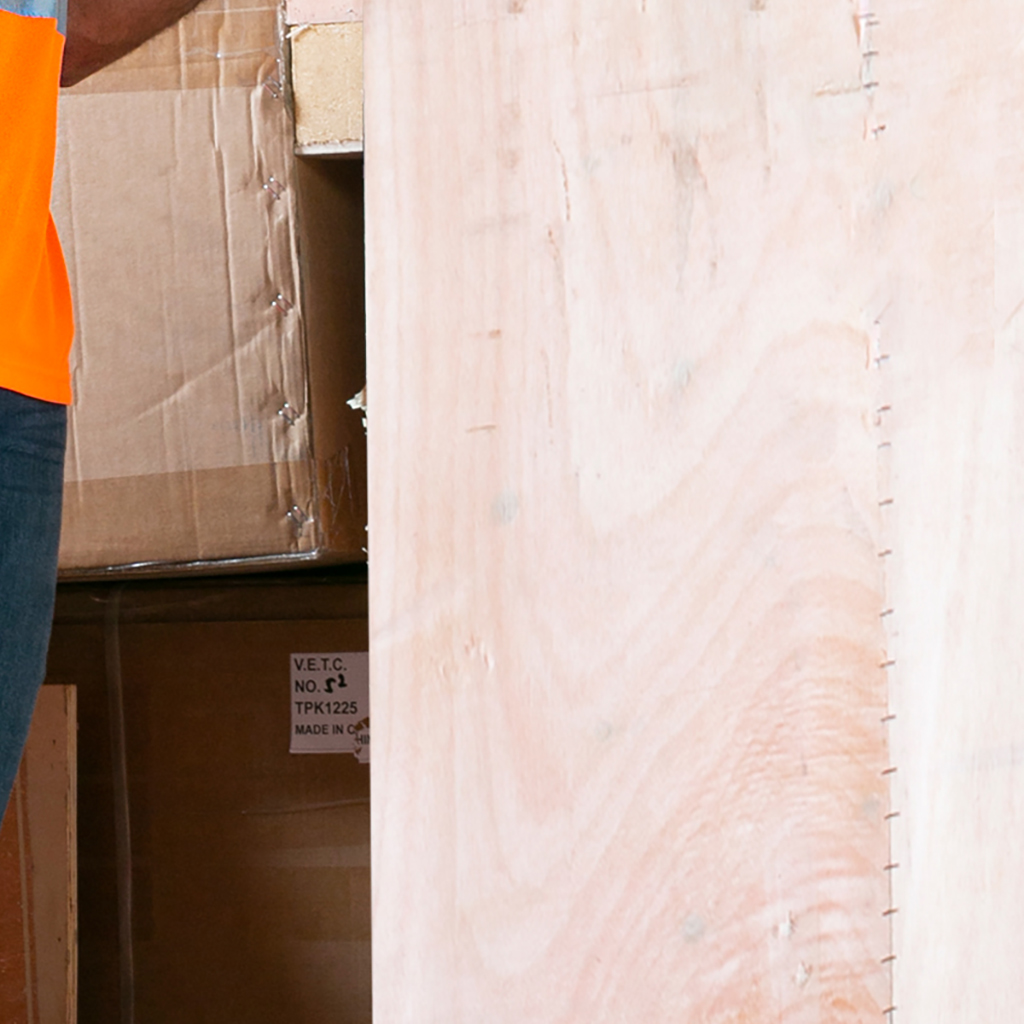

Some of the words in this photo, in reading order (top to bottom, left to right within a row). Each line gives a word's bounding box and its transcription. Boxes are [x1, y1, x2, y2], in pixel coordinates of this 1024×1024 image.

[294, 658, 347, 672] V.E.T.C.
[295, 679, 321, 693] NO.
[294, 701, 358, 715] TPK1225
[295, 724, 329, 735] MADE
[332, 724, 344, 735] IN
